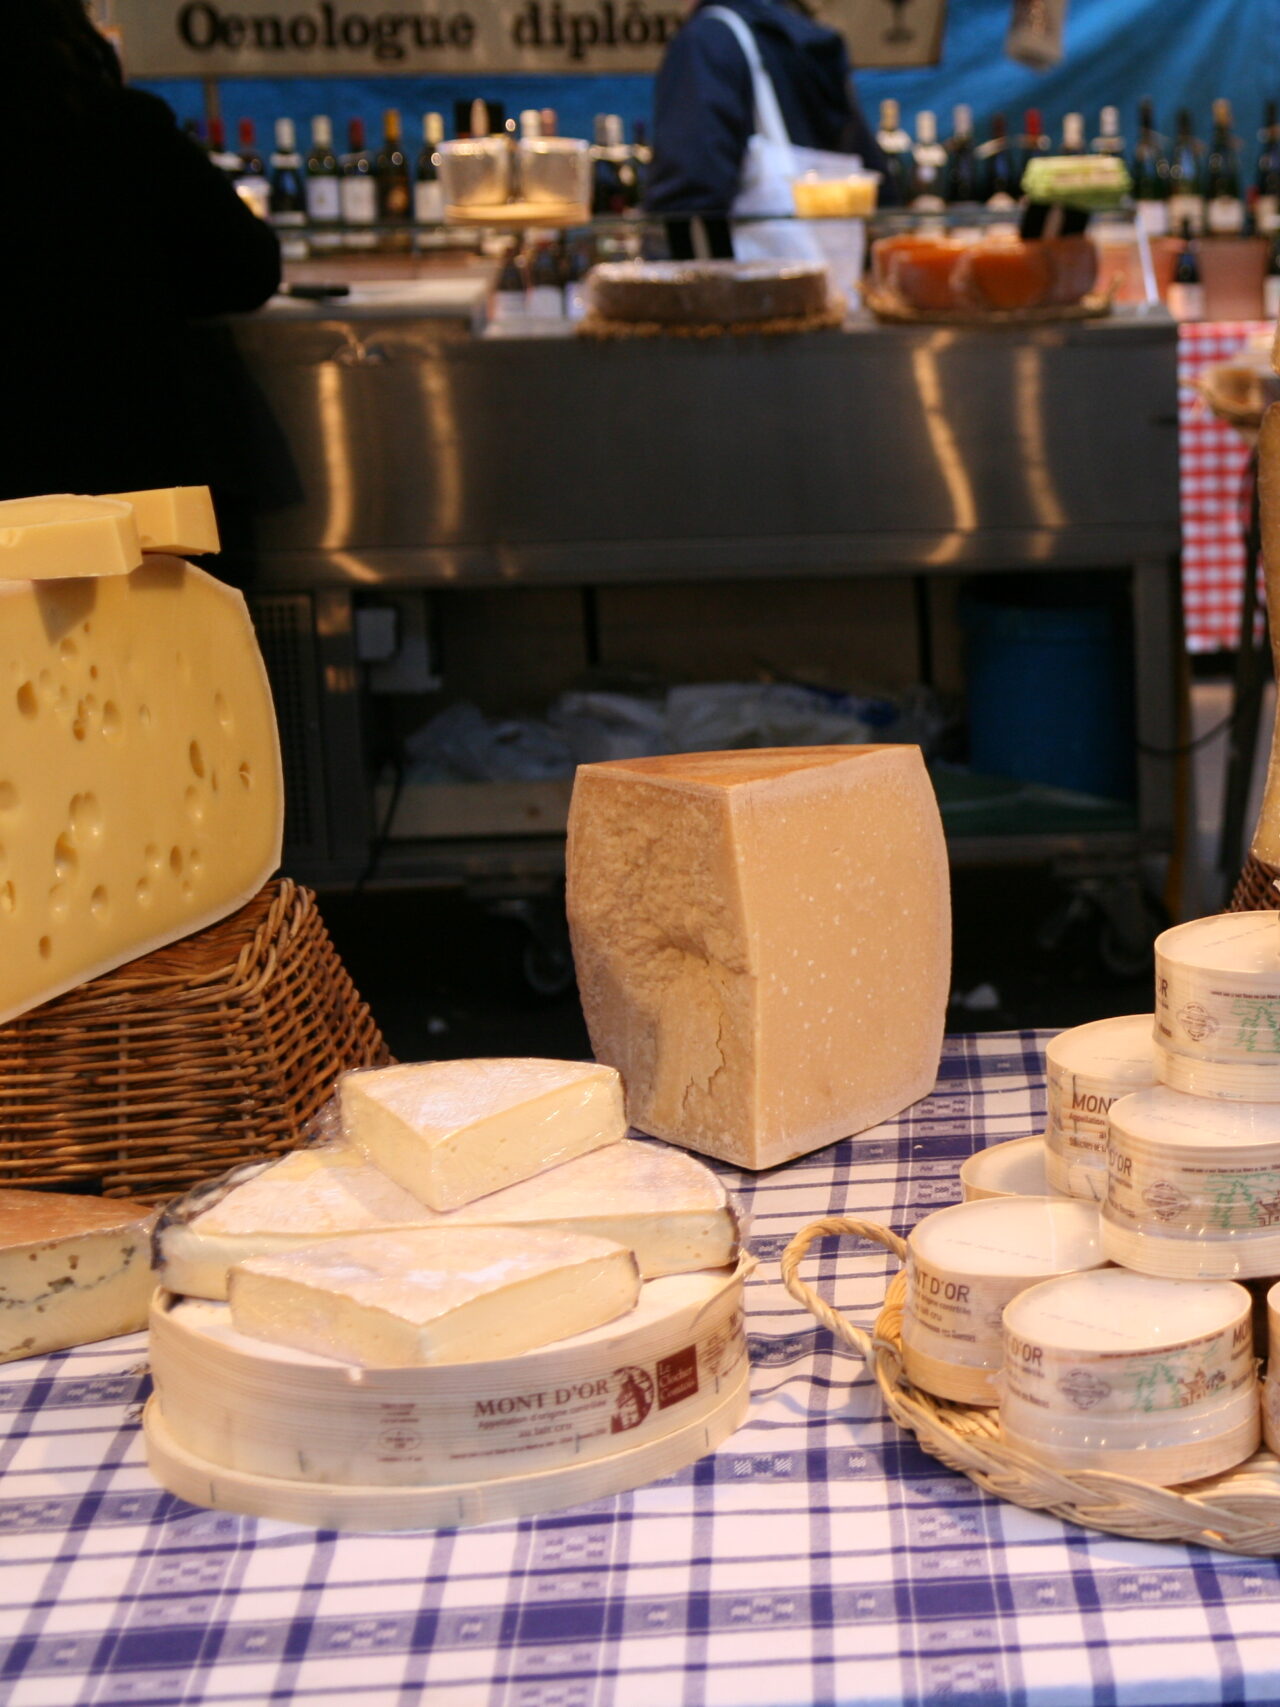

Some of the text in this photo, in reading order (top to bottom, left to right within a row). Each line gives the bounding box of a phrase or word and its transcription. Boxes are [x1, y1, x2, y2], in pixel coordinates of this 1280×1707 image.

[177, 1, 474, 61] Oenologue
[929, 1277, 969, 1303] D'OR
[473, 1378, 610, 1417] MONT D'OR
